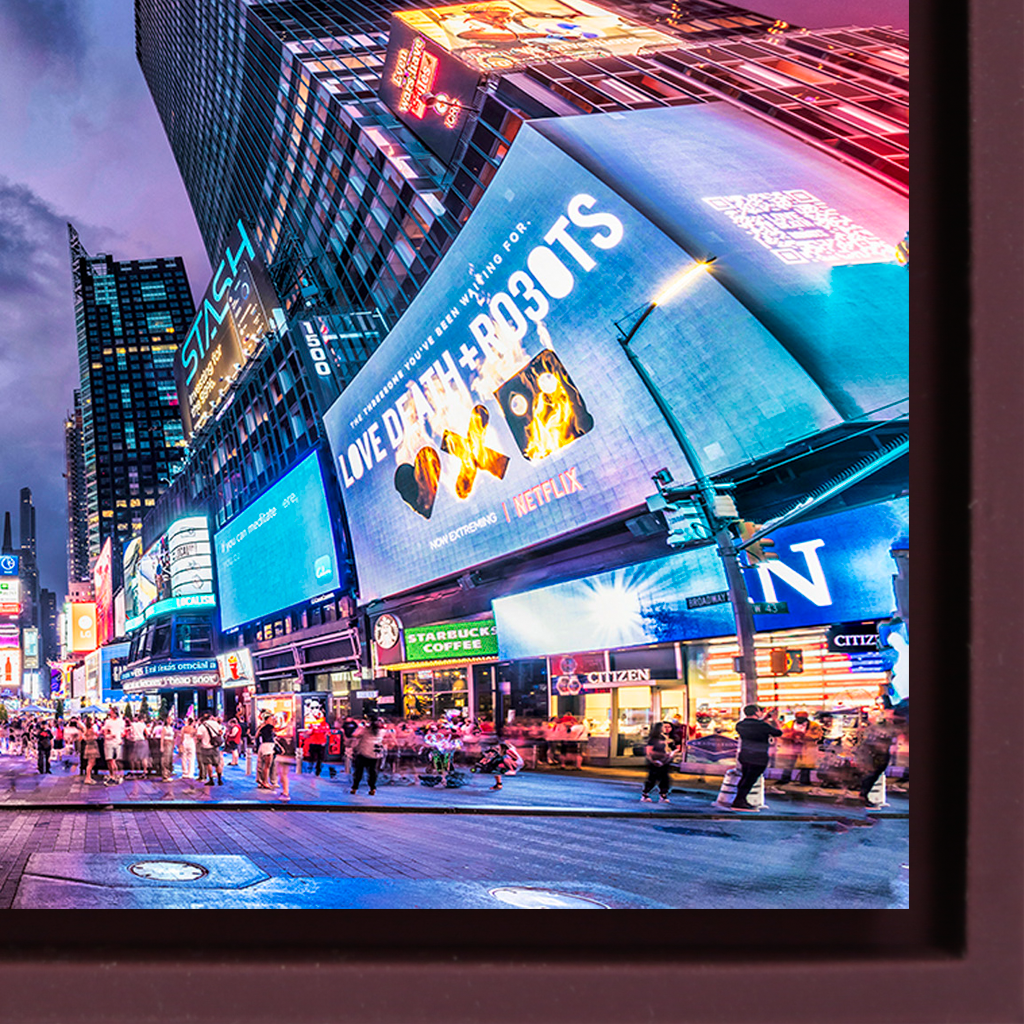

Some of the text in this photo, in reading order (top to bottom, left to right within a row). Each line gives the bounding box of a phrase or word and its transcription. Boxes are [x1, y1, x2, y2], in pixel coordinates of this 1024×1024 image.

[393, 48, 409, 86] Even
[400, 39, 424, 112] wars have
[181, 219, 256, 386] STASH
[349, 414, 364, 429] THE
[404, 334, 436, 371] YOU'VE
[435, 307, 461, 336] BEEN
[459, 253, 504, 307] WAITING
[503, 220, 532, 253] FOR.
[303, 321, 331, 376] 1500
[189, 344, 222, 406] Investing for
[338, 420, 388, 489] LOVE
[236, 528, 248, 543] can
[247, 506, 278, 535] meditate
[429, 466, 585, 551] NOW EXTREMING NETFLIX
[688, 593, 727, 609] BROADWAY
[764, 605, 779, 613] 43
[80, 630, 92, 638] LG
[408, 626, 497, 644] STARBUCKS
[422, 639, 482, 653] COFFEE
[834, 634, 879, 647] CITIZ
[587, 668, 650, 684] CITIZEN
